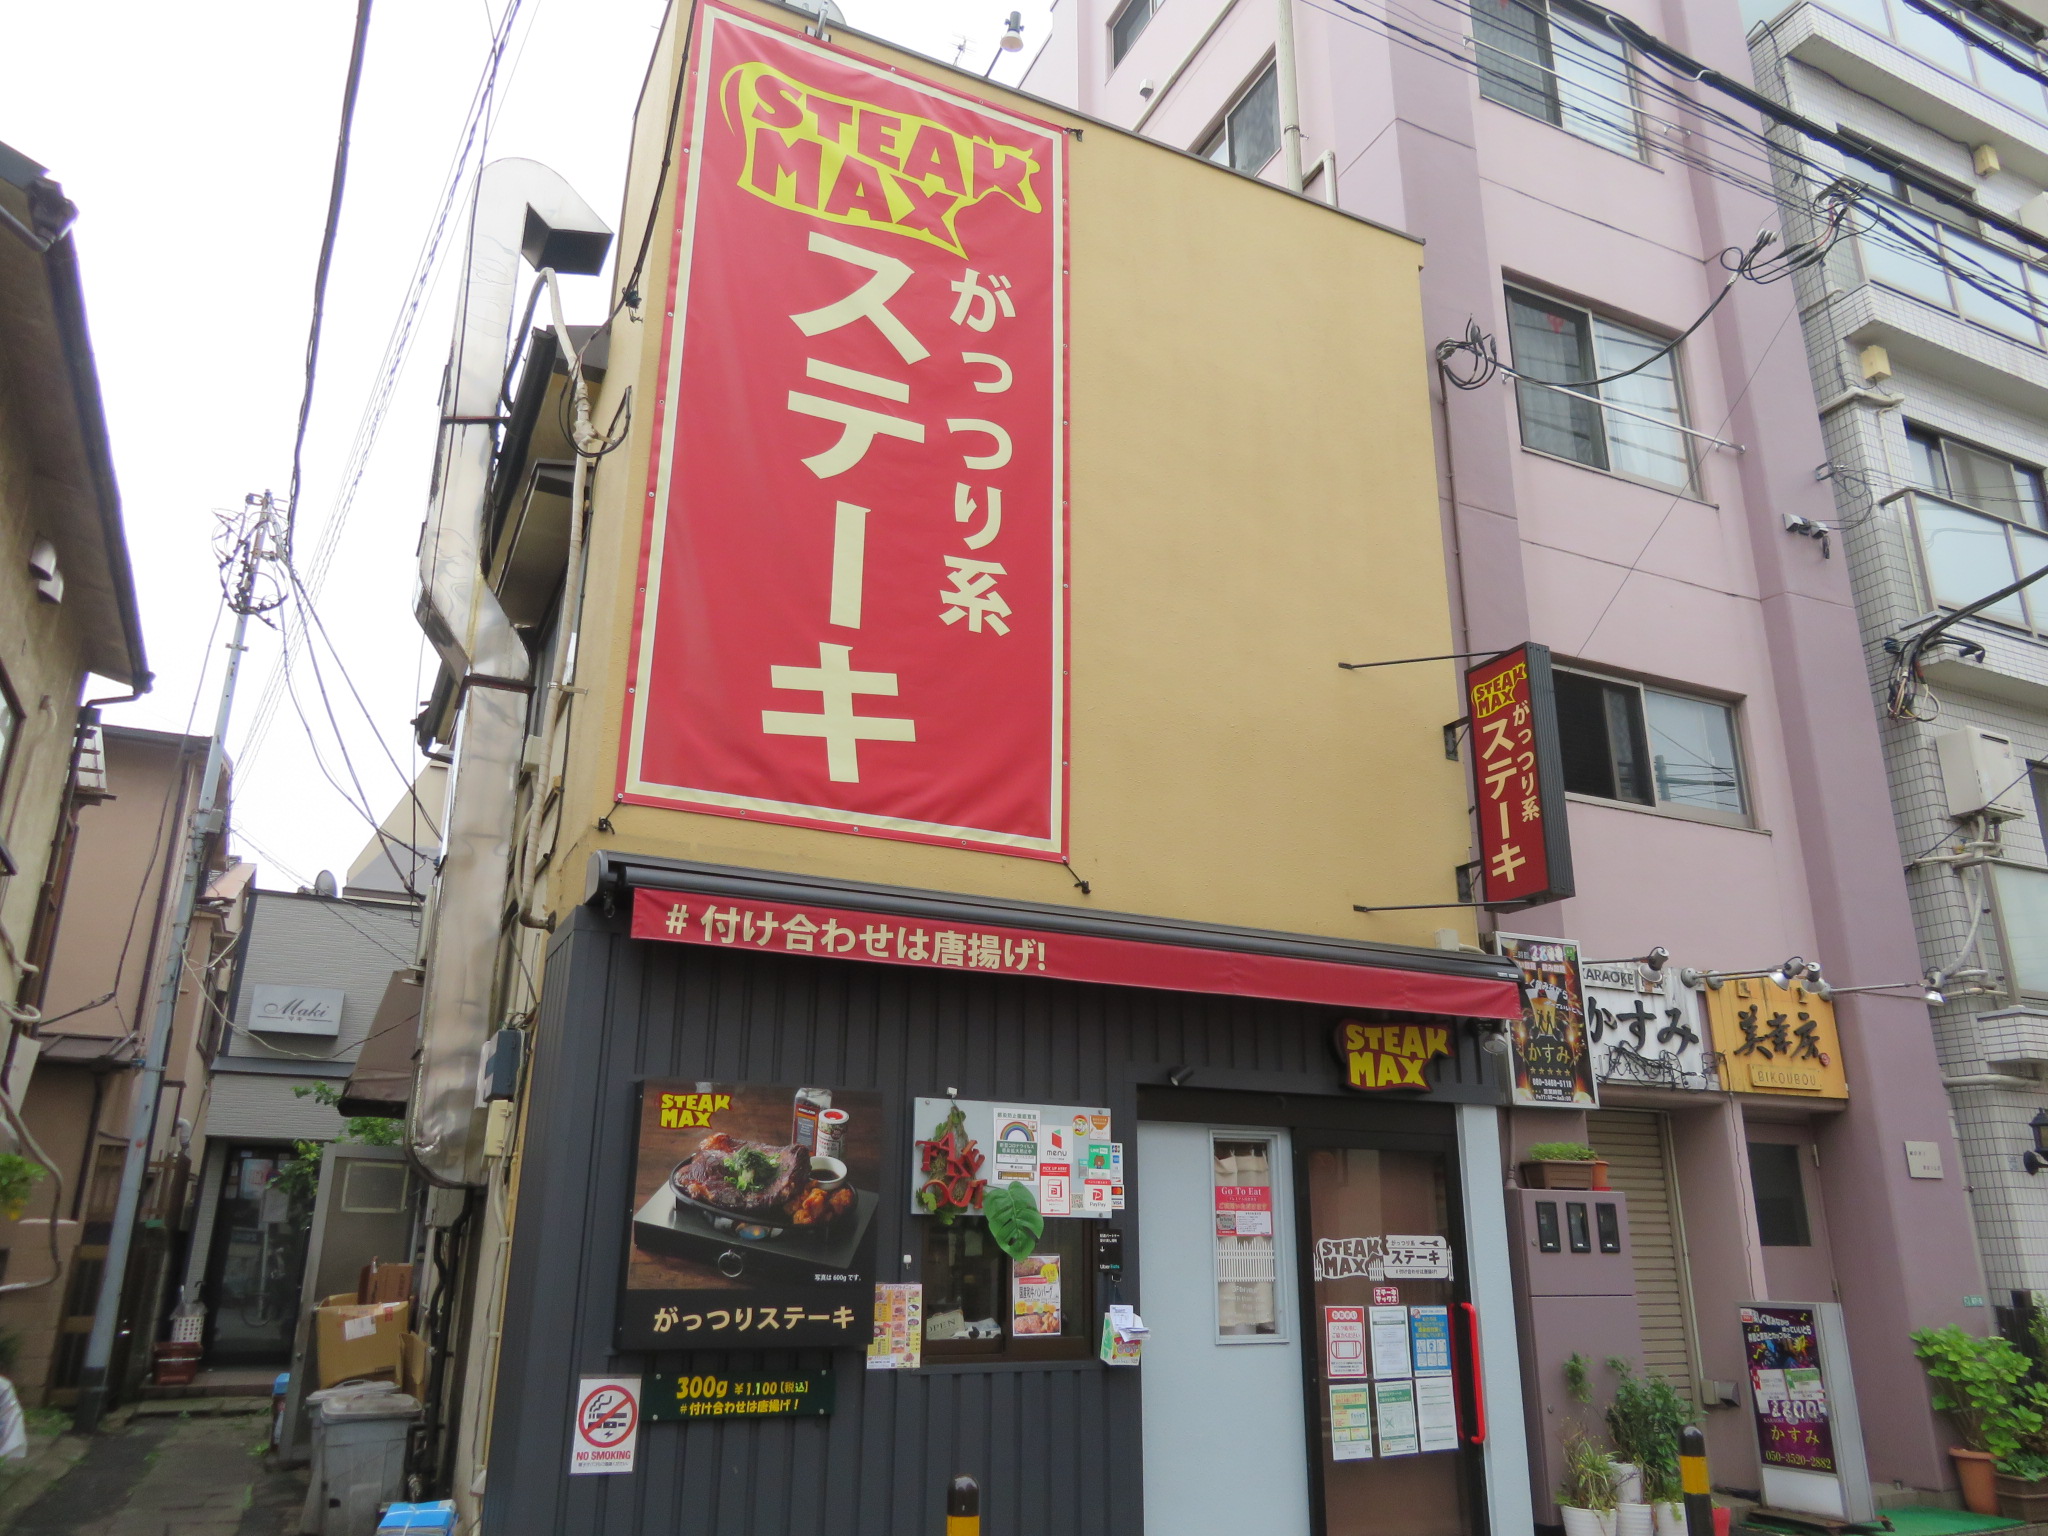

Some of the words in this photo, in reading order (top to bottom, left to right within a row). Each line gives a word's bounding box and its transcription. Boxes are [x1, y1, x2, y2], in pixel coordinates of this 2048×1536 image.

[752, 74, 1028, 200] STEAK
[751, 127, 959, 236] MAX
[938, 268, 1016, 636] がっつり系
[761, 231, 931, 784] ステーキ
[1476, 665, 1525, 700] STEAK
[1478, 690, 1512, 716] MAX
[1512, 700, 1541, 823] がっつり系
[1482, 718, 1527, 883] ステーキ
[264, 998, 331, 1018] Maki
[1588, 996, 1699, 1056] かすみ
[1346, 1024, 1449, 1059] STEAK
[1528, 1043, 1571, 1064] かすみ
[1349, 1051, 1427, 1087] MAX
[1758, 1071, 1816, 1085] BIKOUBOU
[661, 1094, 731, 1113] STEAK
[660, 1108, 711, 1128] MAX
[1221, 1187, 1233, 1195] Go
[1236, 1187, 1246, 1195] To
[1248, 1187, 1261, 1196] Eat
[1323, 1239, 1381, 1258] STEAK
[1391, 1250, 1440, 1266] ステーキ
[1324, 1256, 1366, 1277] MAX
[653, 1306, 855, 1333] がっつりステーキ
[676, 1376, 728, 1399] 300g
[1771, 1425, 1820, 1446] かすみ
[576, 1451, 589, 1460] NO
[591, 1450, 631, 1460] SMOKING
[1765, 1450, 1832, 1470] 050-3520-2882
